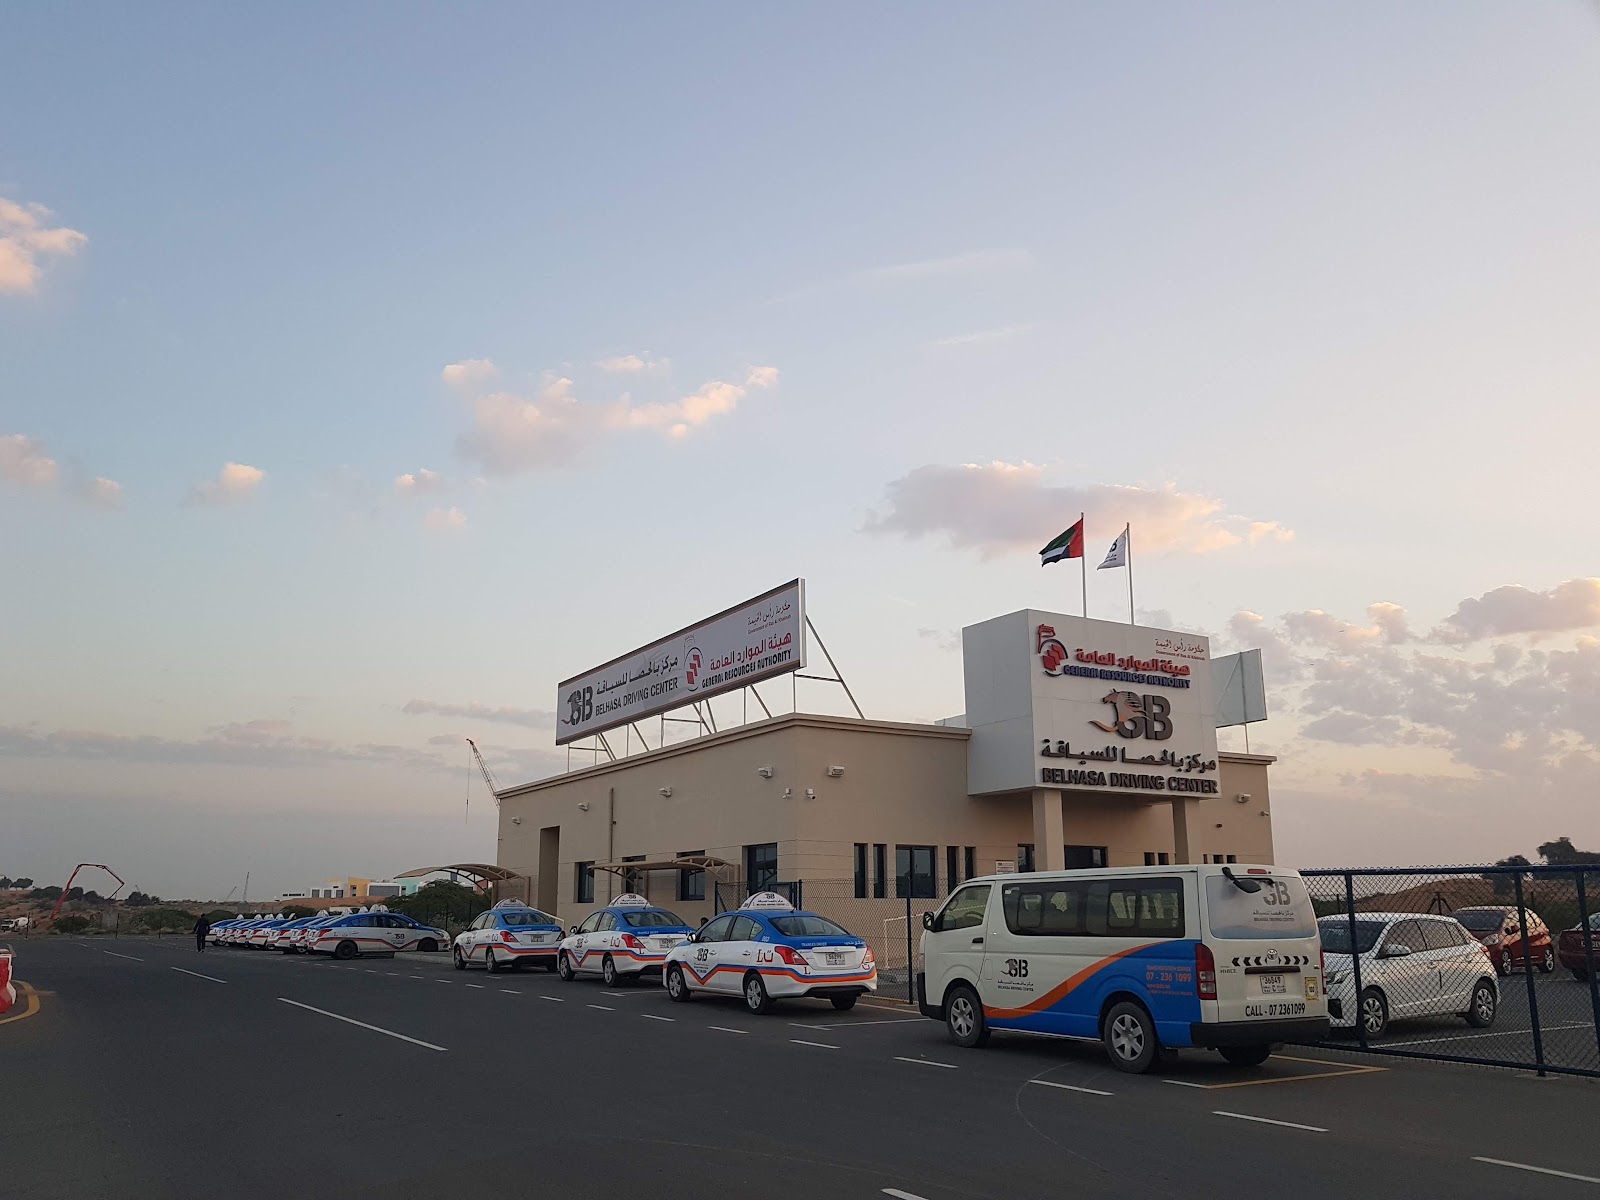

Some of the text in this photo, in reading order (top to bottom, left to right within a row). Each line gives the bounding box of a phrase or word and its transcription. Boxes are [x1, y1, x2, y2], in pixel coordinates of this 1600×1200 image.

[660, 654, 679, 676] مركز
[710, 633, 792, 671] هيئة الموارد العامة
[1075, 648, 1191, 678] هيئة الموارد العامة
[701, 649, 792, 689] GENERAL RESOURCES AUTHORITY
[1063, 664, 1191, 689] GENERAL RESOURCES AUTHORITY
[595, 677, 679, 716] BELHASA DRIVING CENTER
[1185, 752, 1218, 774] مركز
[1042, 768, 1220, 794] BELHASA DRIVING CENTER
[1245, 1004, 1264, 1017] CALL
[1268, 1004, 1278, 1016] 07
[1278, 1002, 1306, 1016] 2361099
